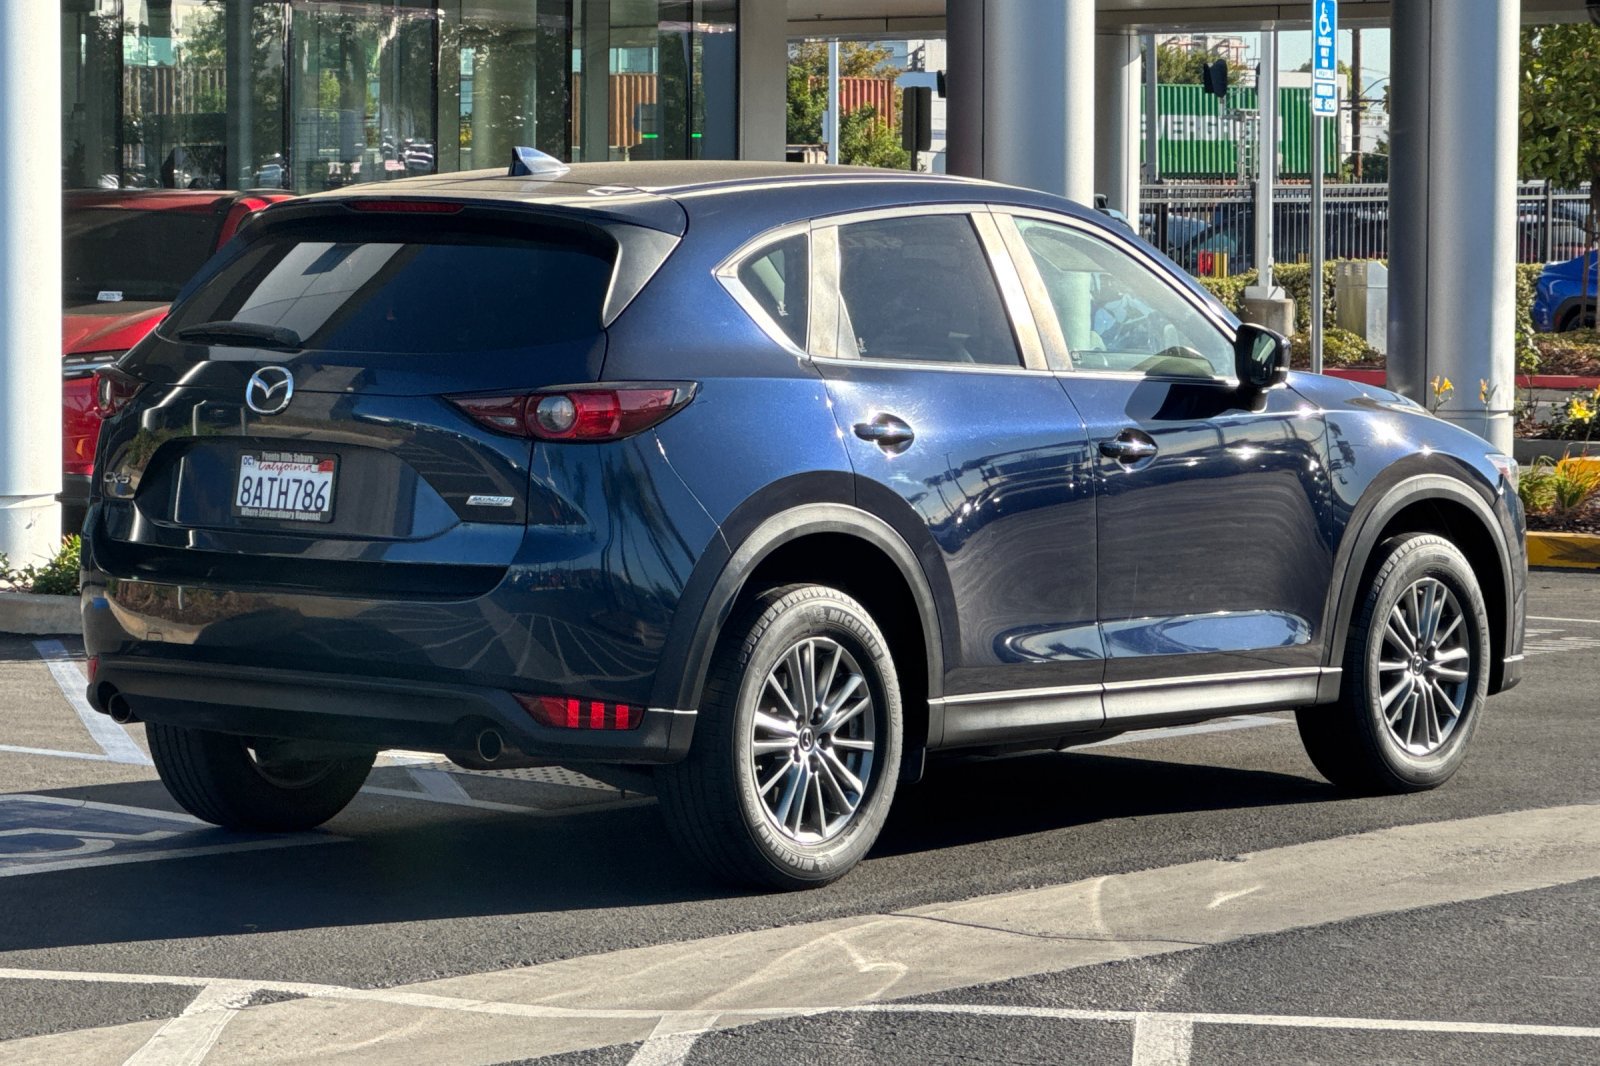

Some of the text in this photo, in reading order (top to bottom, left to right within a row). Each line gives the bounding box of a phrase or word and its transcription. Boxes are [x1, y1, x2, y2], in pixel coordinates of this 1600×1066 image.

[240, 476, 328, 512] 8ATH786
[828, 609, 882, 659] MICHELIN
[758, 825, 815, 872] MICHELIN
